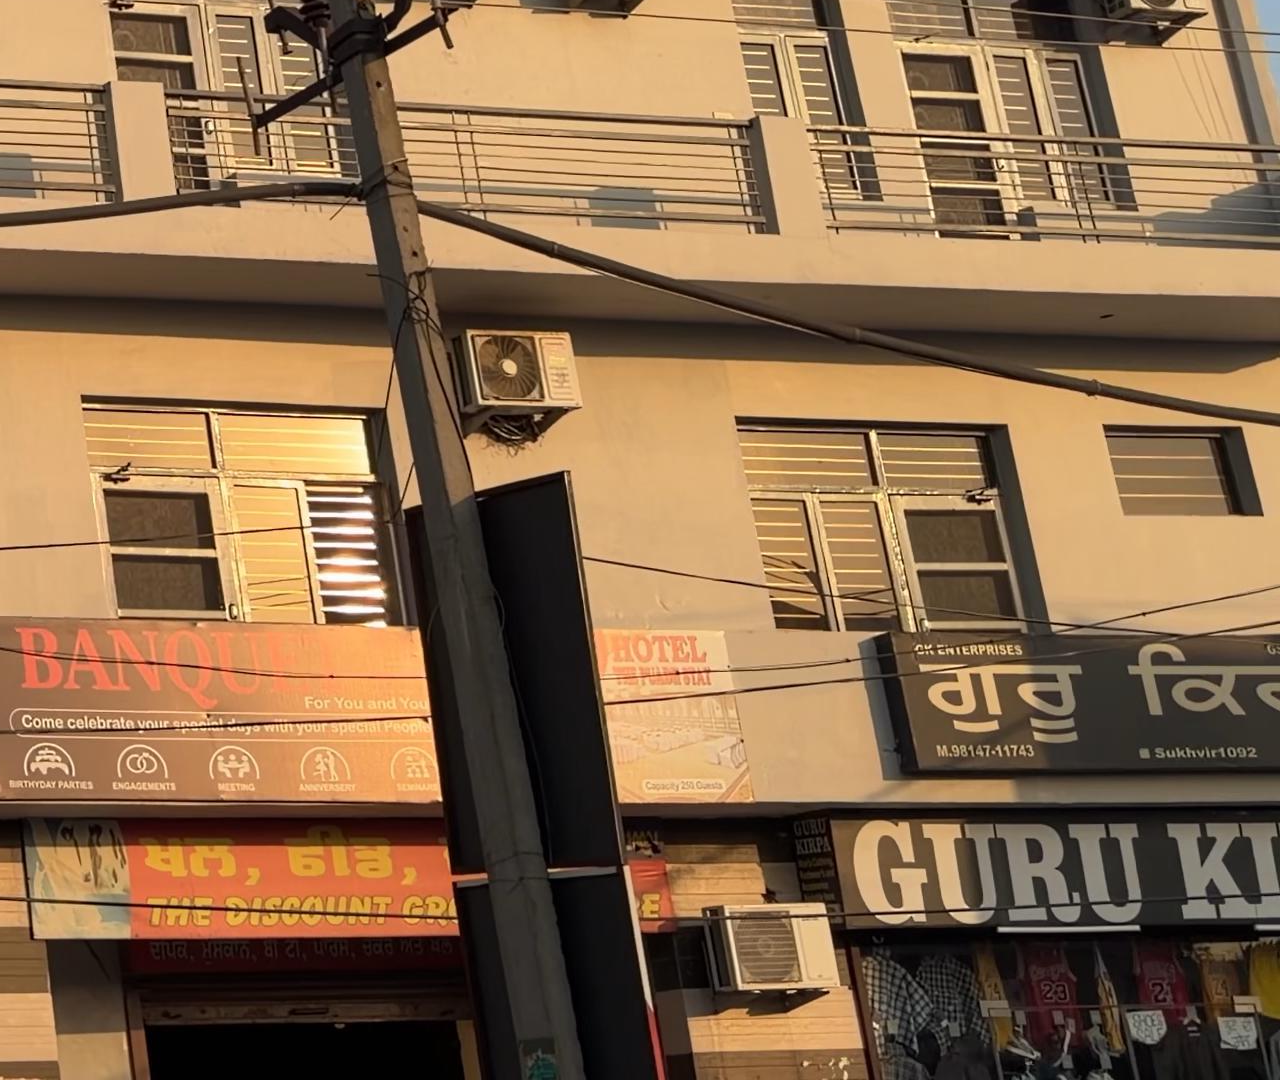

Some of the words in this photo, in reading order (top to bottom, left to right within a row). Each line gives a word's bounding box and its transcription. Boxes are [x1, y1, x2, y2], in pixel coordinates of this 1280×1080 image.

[610, 634, 707, 663] HOTEL
[937, 644, 1023, 656] ENTERPRISES
[305, 697, 330, 709] For
[334, 697, 363, 709] You
[367, 697, 397, 710] and
[400, 697, 429, 710] You
[919, 664, 1082, 743] ਗੁਰੂ
[21, 714, 63, 729] Come
[67, 715, 134, 730] celebrate
[138, 719, 170, 733] your
[264, 719, 294, 733] with
[297, 722, 327, 735] your
[332, 720, 380, 736] special
[1155, 747, 1257, 759] Sukhvir1092
[58, 780, 93, 790] PARTIES
[112, 782, 176, 791] ENGAGEMENTS
[218, 783, 255, 792] MEETING
[794, 818, 827, 837] GURU
[795, 836, 831, 855] KIRPA
[852, 819, 1142, 925] GURU
[146, 896, 215, 927] THE
[224, 895, 393, 927] DISCOUNT
[1041, 980, 1070, 1003] 23
